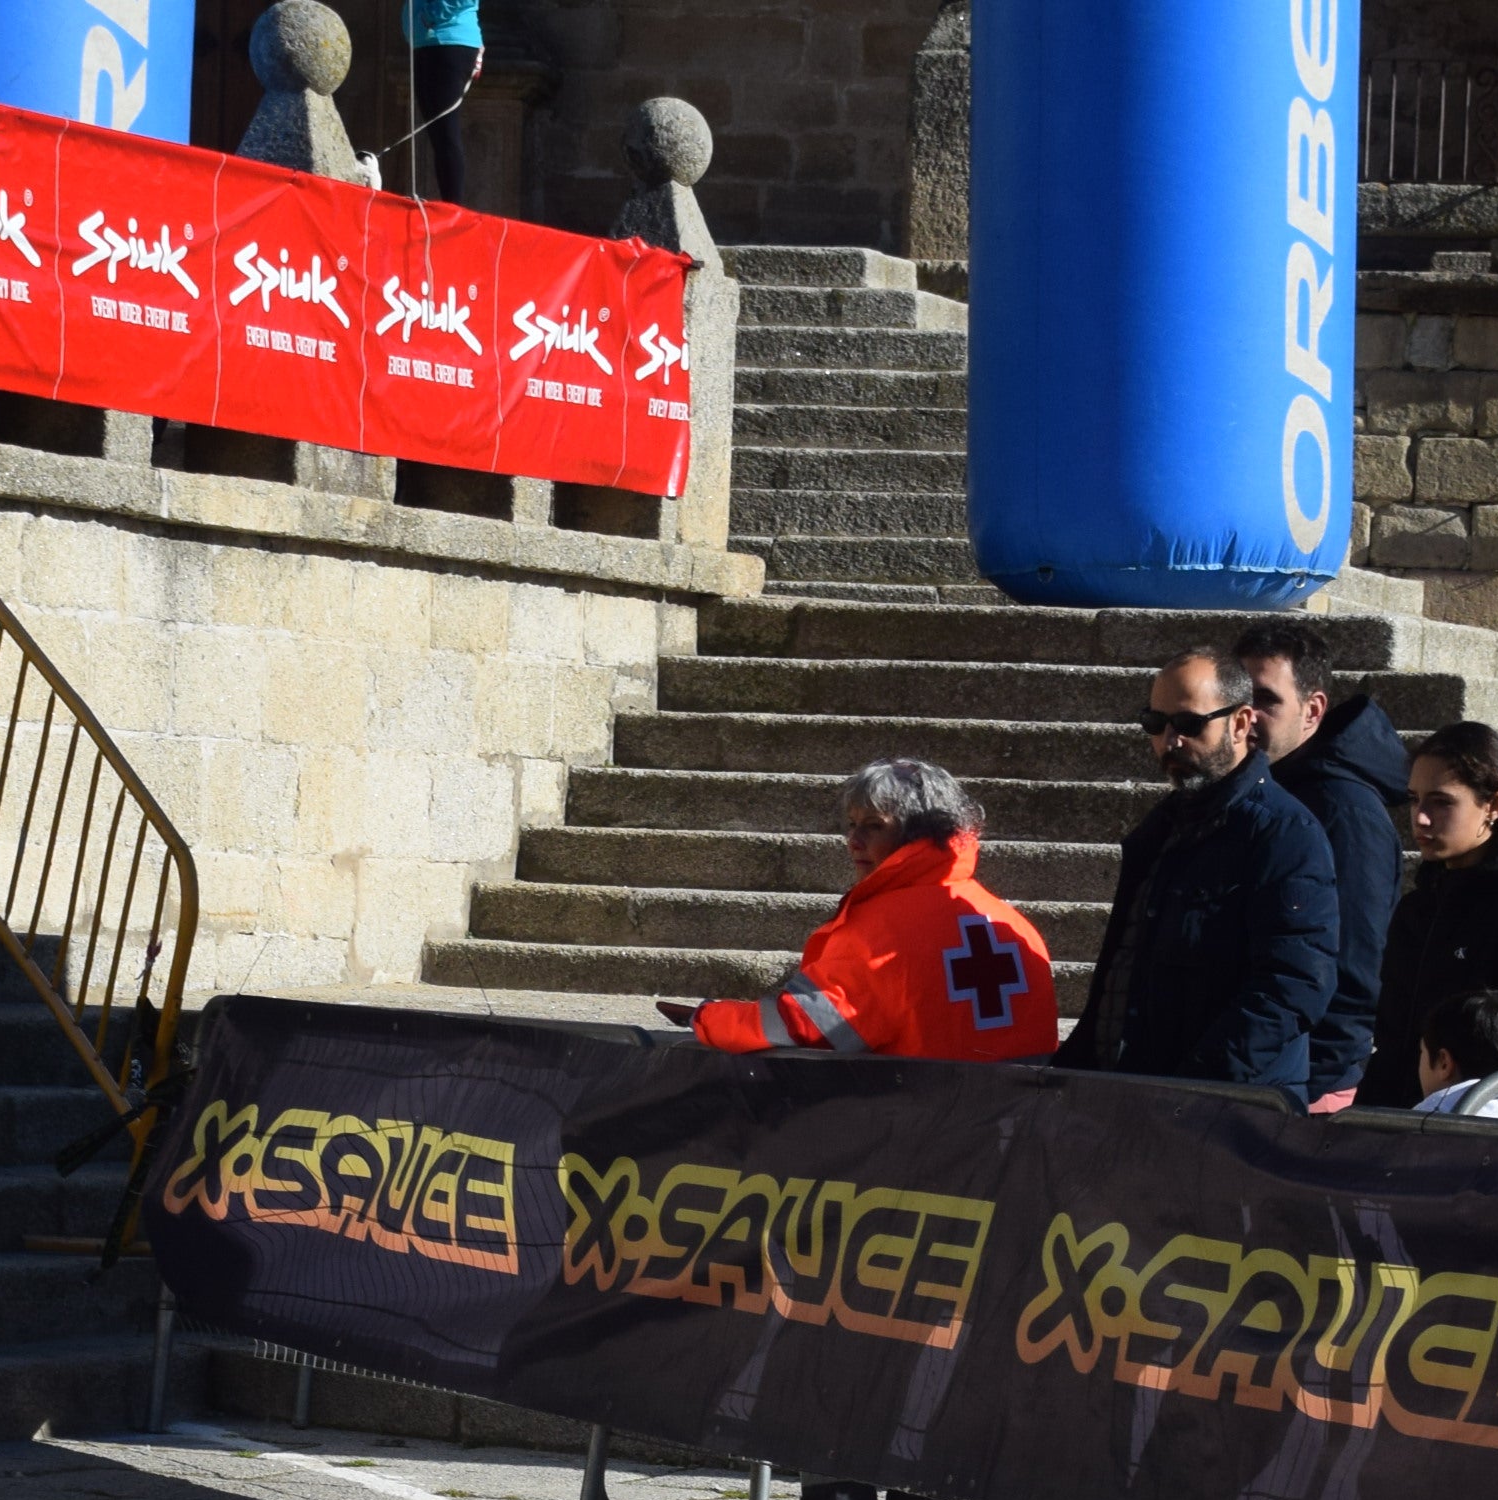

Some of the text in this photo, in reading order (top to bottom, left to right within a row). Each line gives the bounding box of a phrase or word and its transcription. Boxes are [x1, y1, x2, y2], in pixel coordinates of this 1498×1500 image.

[72, 210, 200, 299] Spiuk
[229, 242, 350, 329] Spiuk
[376, 276, 482, 356] Spiuk
[509, 301, 613, 375] Spiuk
